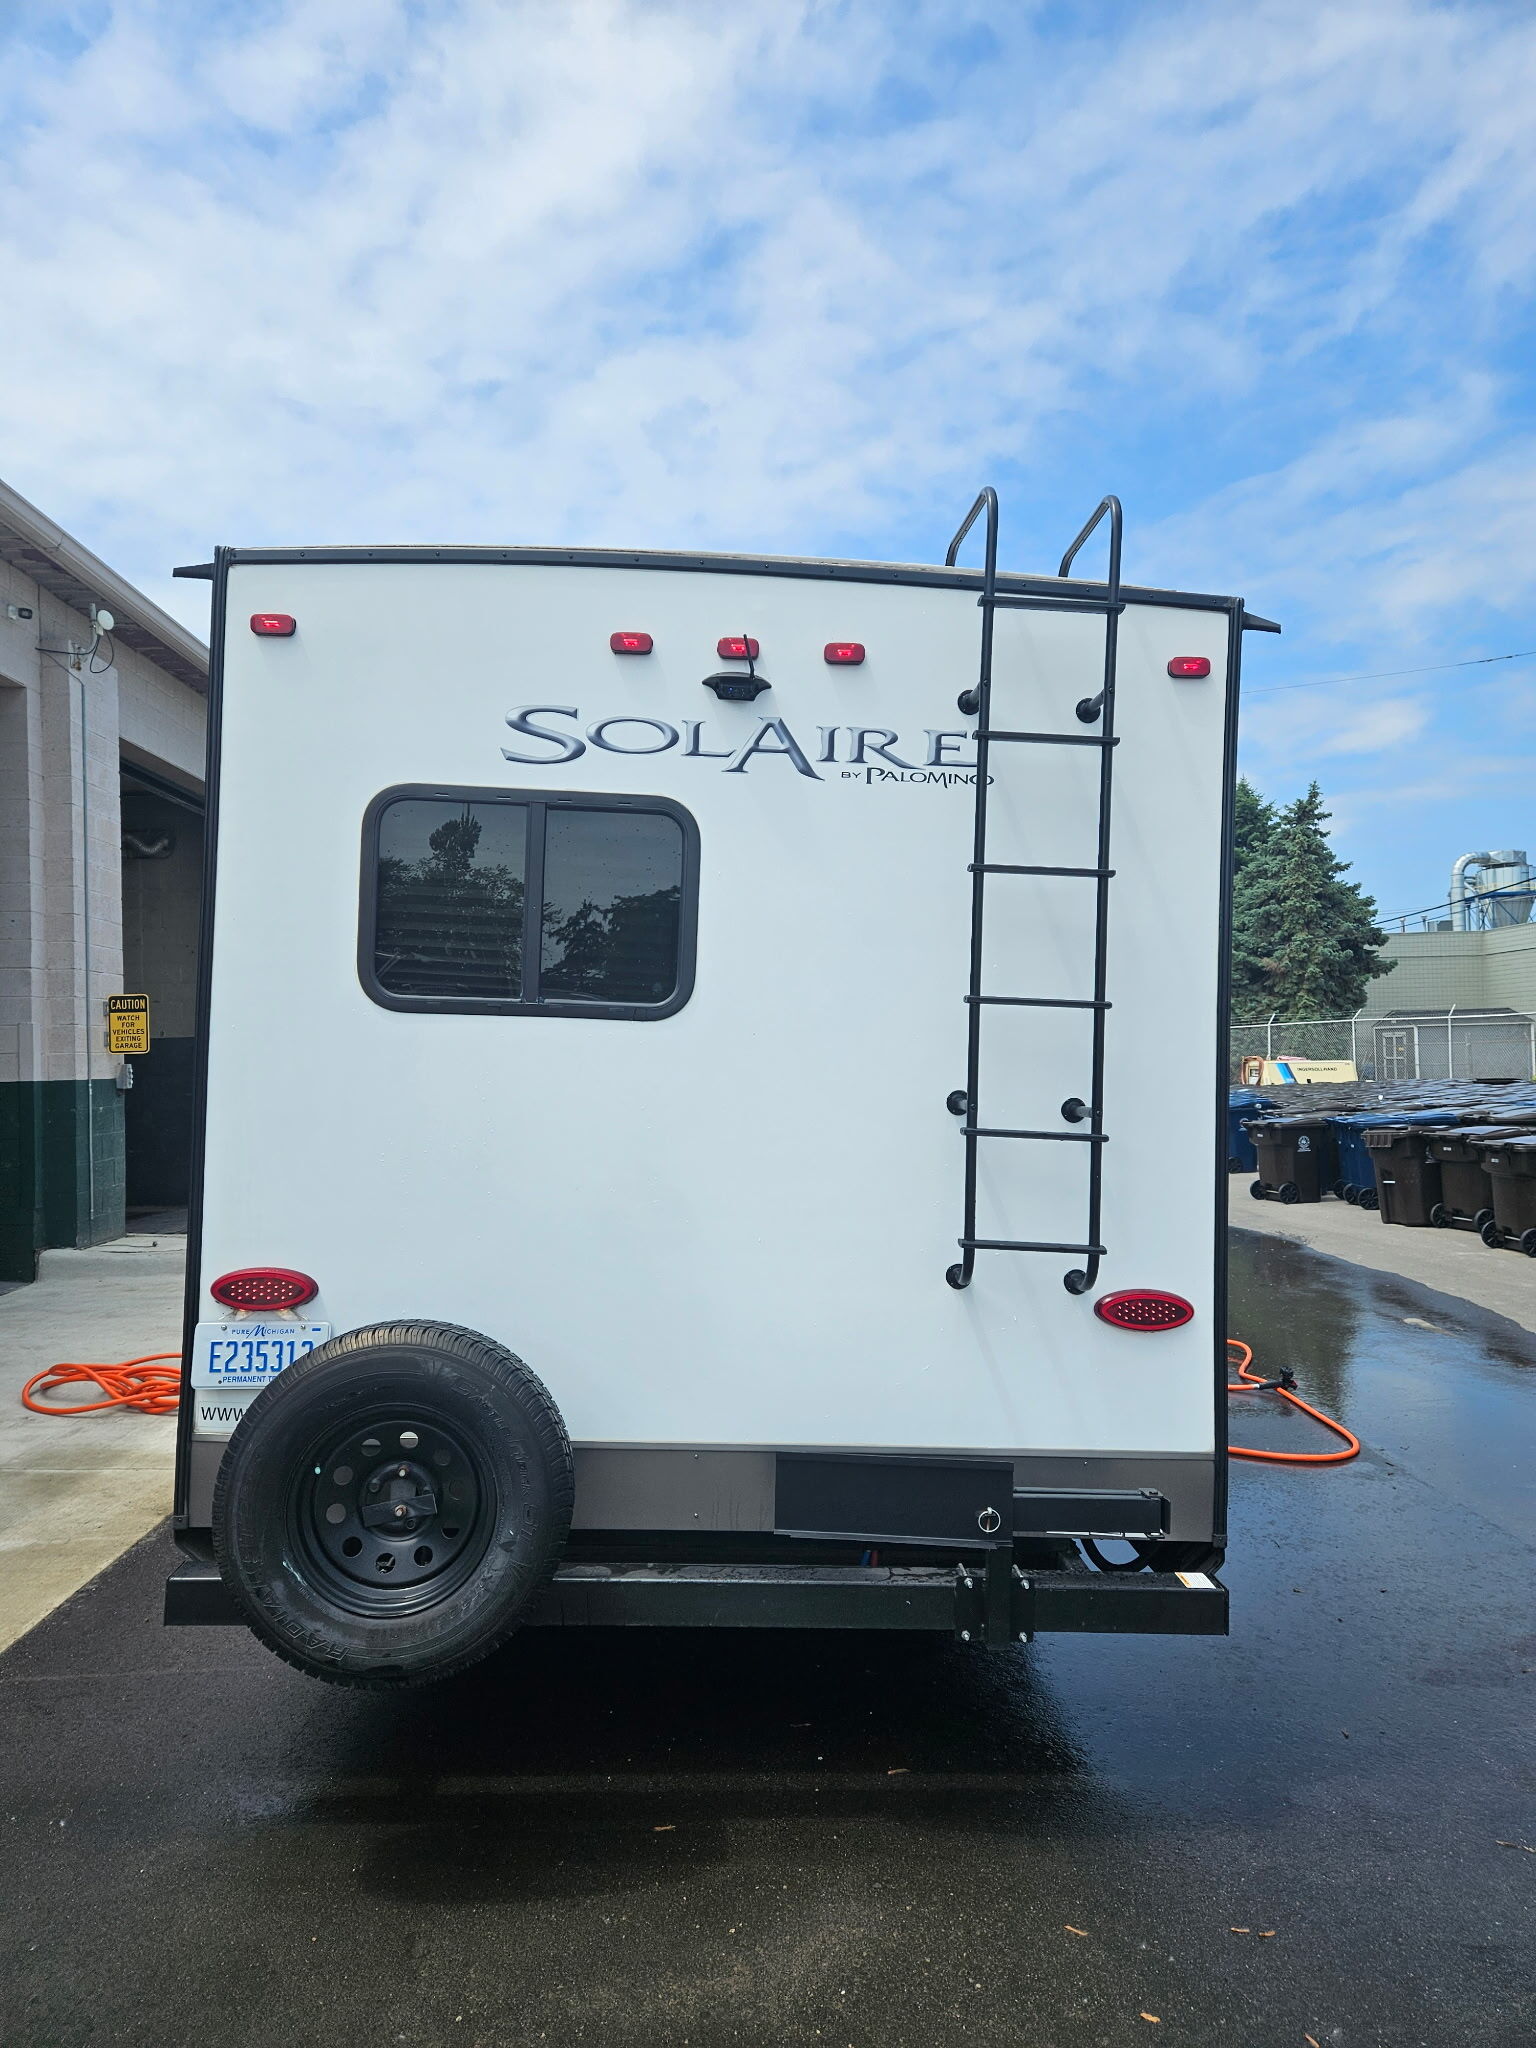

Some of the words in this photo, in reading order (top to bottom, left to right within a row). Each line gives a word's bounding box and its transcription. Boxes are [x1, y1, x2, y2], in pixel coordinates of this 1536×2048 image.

[110, 999, 145, 1009] CAUTION
[246, 1325, 295, 1339] MICHIGAN
[222, 1375, 266, 1383] PERMANENT
